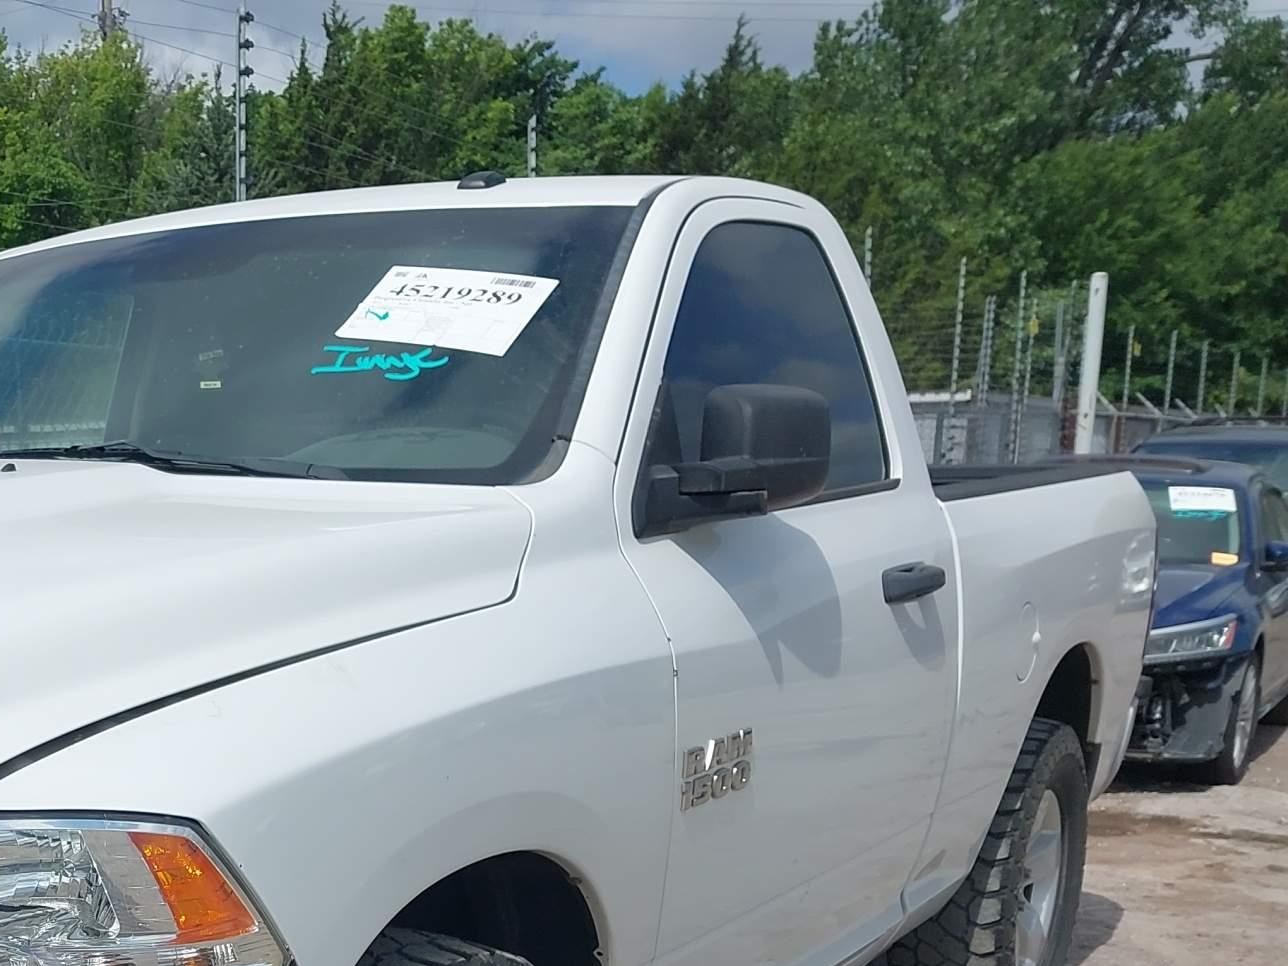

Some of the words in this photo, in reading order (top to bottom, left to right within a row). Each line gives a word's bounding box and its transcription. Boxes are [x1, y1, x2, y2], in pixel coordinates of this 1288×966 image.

[389, 283, 524, 307] 45219289
[683, 728, 753, 779] RAM
[680, 760, 752, 812] 1500
